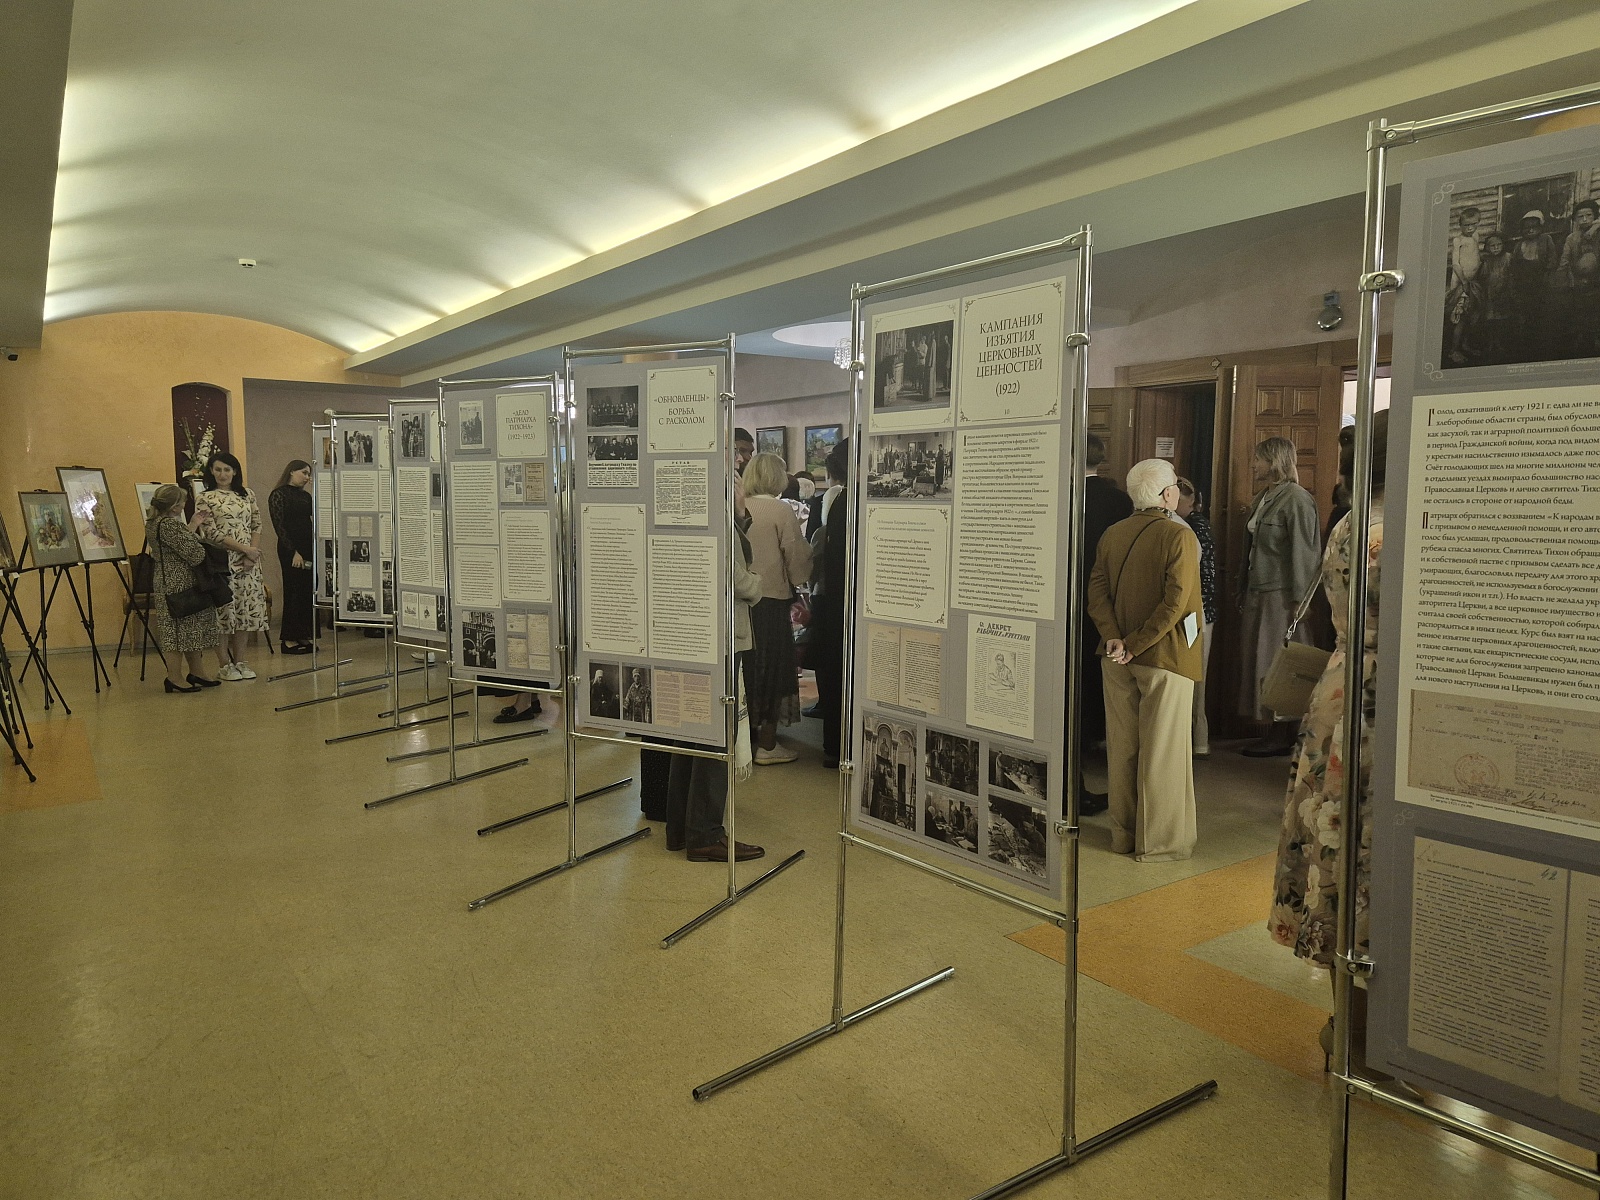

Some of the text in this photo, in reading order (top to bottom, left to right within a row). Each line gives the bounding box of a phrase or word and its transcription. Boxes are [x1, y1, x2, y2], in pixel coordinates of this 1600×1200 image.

[980, 312, 1043, 334] КАМПАНИЯ
[986, 329, 1035, 347] ИЗЪЯТИЯ
[979, 344, 1042, 363] ЦЕРКОВНЫХ
[976, 358, 1042, 378] ЦЕННОСТЕЙ
[995, 380, 1020, 397] (1922)
[654, 394, 710, 403] «ОБНОВЛЕНЦЫ»
[668, 407, 695, 415] БОРЬБА
[1456, 404, 1500, 413] охвативший
[1527, 401, 1544, 410] 1921
[1552, 402, 1569, 410] едва
[666, 416, 705, 425] РАСКОЛОМ
[1485, 415, 1515, 423] области
[1516, 415, 1546, 424] страны,
[1440, 428, 1469, 438] засухой,
[1490, 426, 1525, 436] аграрной
[1526, 424, 1569, 433] политикой
[1459, 438, 1506, 449] Гражданской
[1508, 438, 1534, 447] войны,
[1424, 485, 1474, 494] Православная
[1476, 485, 1507, 494] Церковь
[1513, 496, 1551, 506] народной
[1458, 511, 1496, 521] обратился
[1477, 523, 1526, 532] немедленной
[1456, 535, 1490, 544] услышан,
[1420, 544, 1446, 553] рубежа
[1502, 546, 1542, 555] Святитель
[1546, 547, 1569, 555] Тихон
[1431, 555, 1477, 564] собственной
[1420, 568, 1463, 577] умирающих,
[1514, 571, 1549, 580] передачу
[1542, 582, 1598, 593] богослужении
[1506, 592, 1518, 600] Но
[1418, 600, 1456, 608] авторитета
[1458, 600, 1487, 612] Церкви,
[1507, 605, 1548, 614] церковное
[1550, 608, 1594, 617] имущество
[1467, 612, 1530, 626] собственностью,
[1531, 618, 1564, 627] которой
[987, 622, 1012, 631] ДЕКРЕТ
[1417, 621, 1469, 631] распорядиться
[1520, 627, 1539, 638] Курс
[1541, 629, 1556, 637] был
[1471, 637, 1511, 645] церковных
[1416, 654, 1444, 663] которые
[1469, 656, 1521, 669] богослужения
[1523, 664, 1565, 674] запрещено
[1549, 655, 1578, 665] сосуды,
[1415, 662, 1466, 675] Православной
[1498, 671, 1549, 684] Большевикам
[1550, 678, 1576, 687] нужен
[1577, 679, 1592, 688] был
[1428, 676, 1452, 684] нового
[1453, 679, 1499, 689] наступления
[1511, 683, 1545, 697] Церковь,
